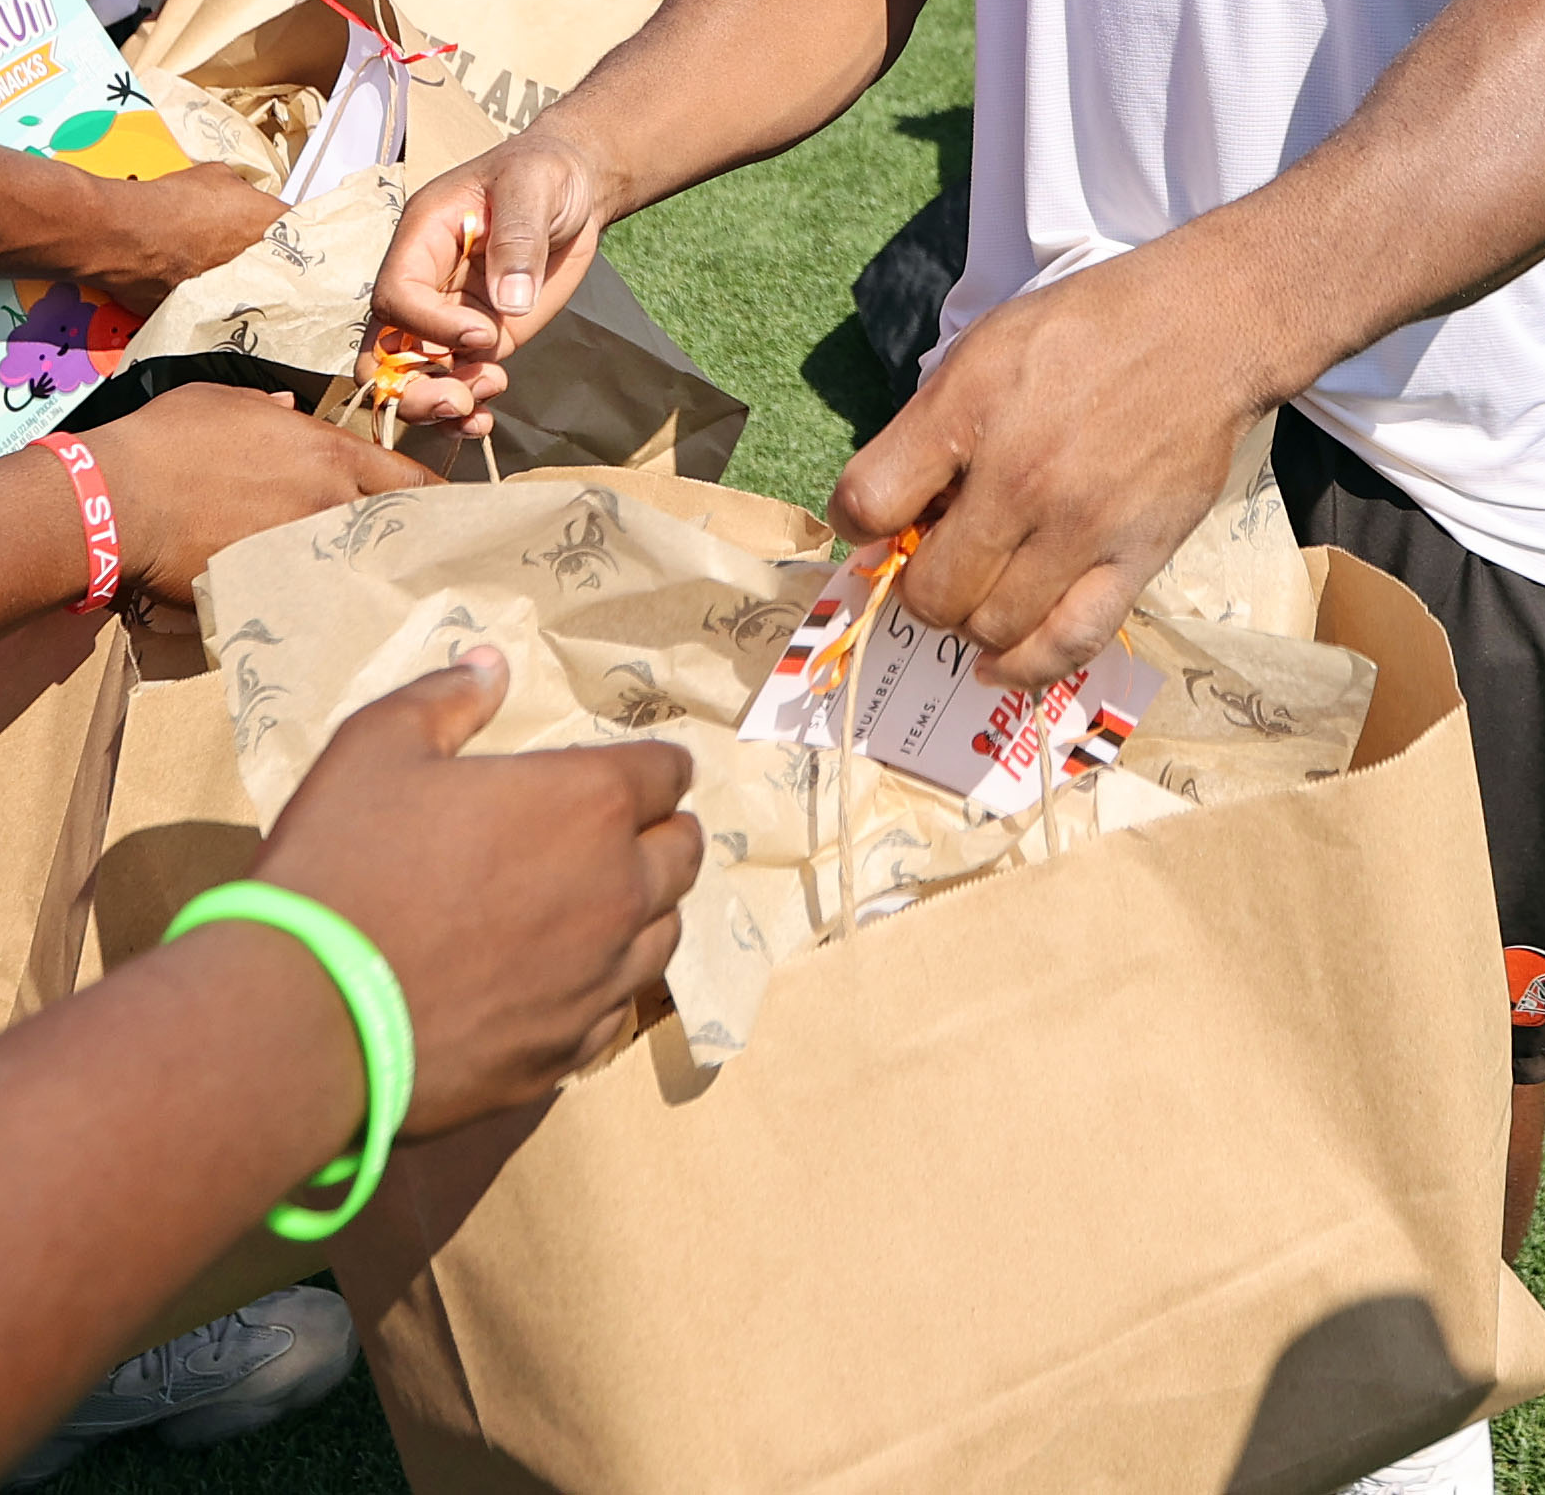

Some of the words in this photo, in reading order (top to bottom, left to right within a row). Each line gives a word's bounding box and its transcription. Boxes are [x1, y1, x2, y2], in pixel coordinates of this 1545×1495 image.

[84, 495, 119, 599] STAY
[855, 657, 905, 739] NUMBER:
[900, 696, 941, 755] ITEMS:
